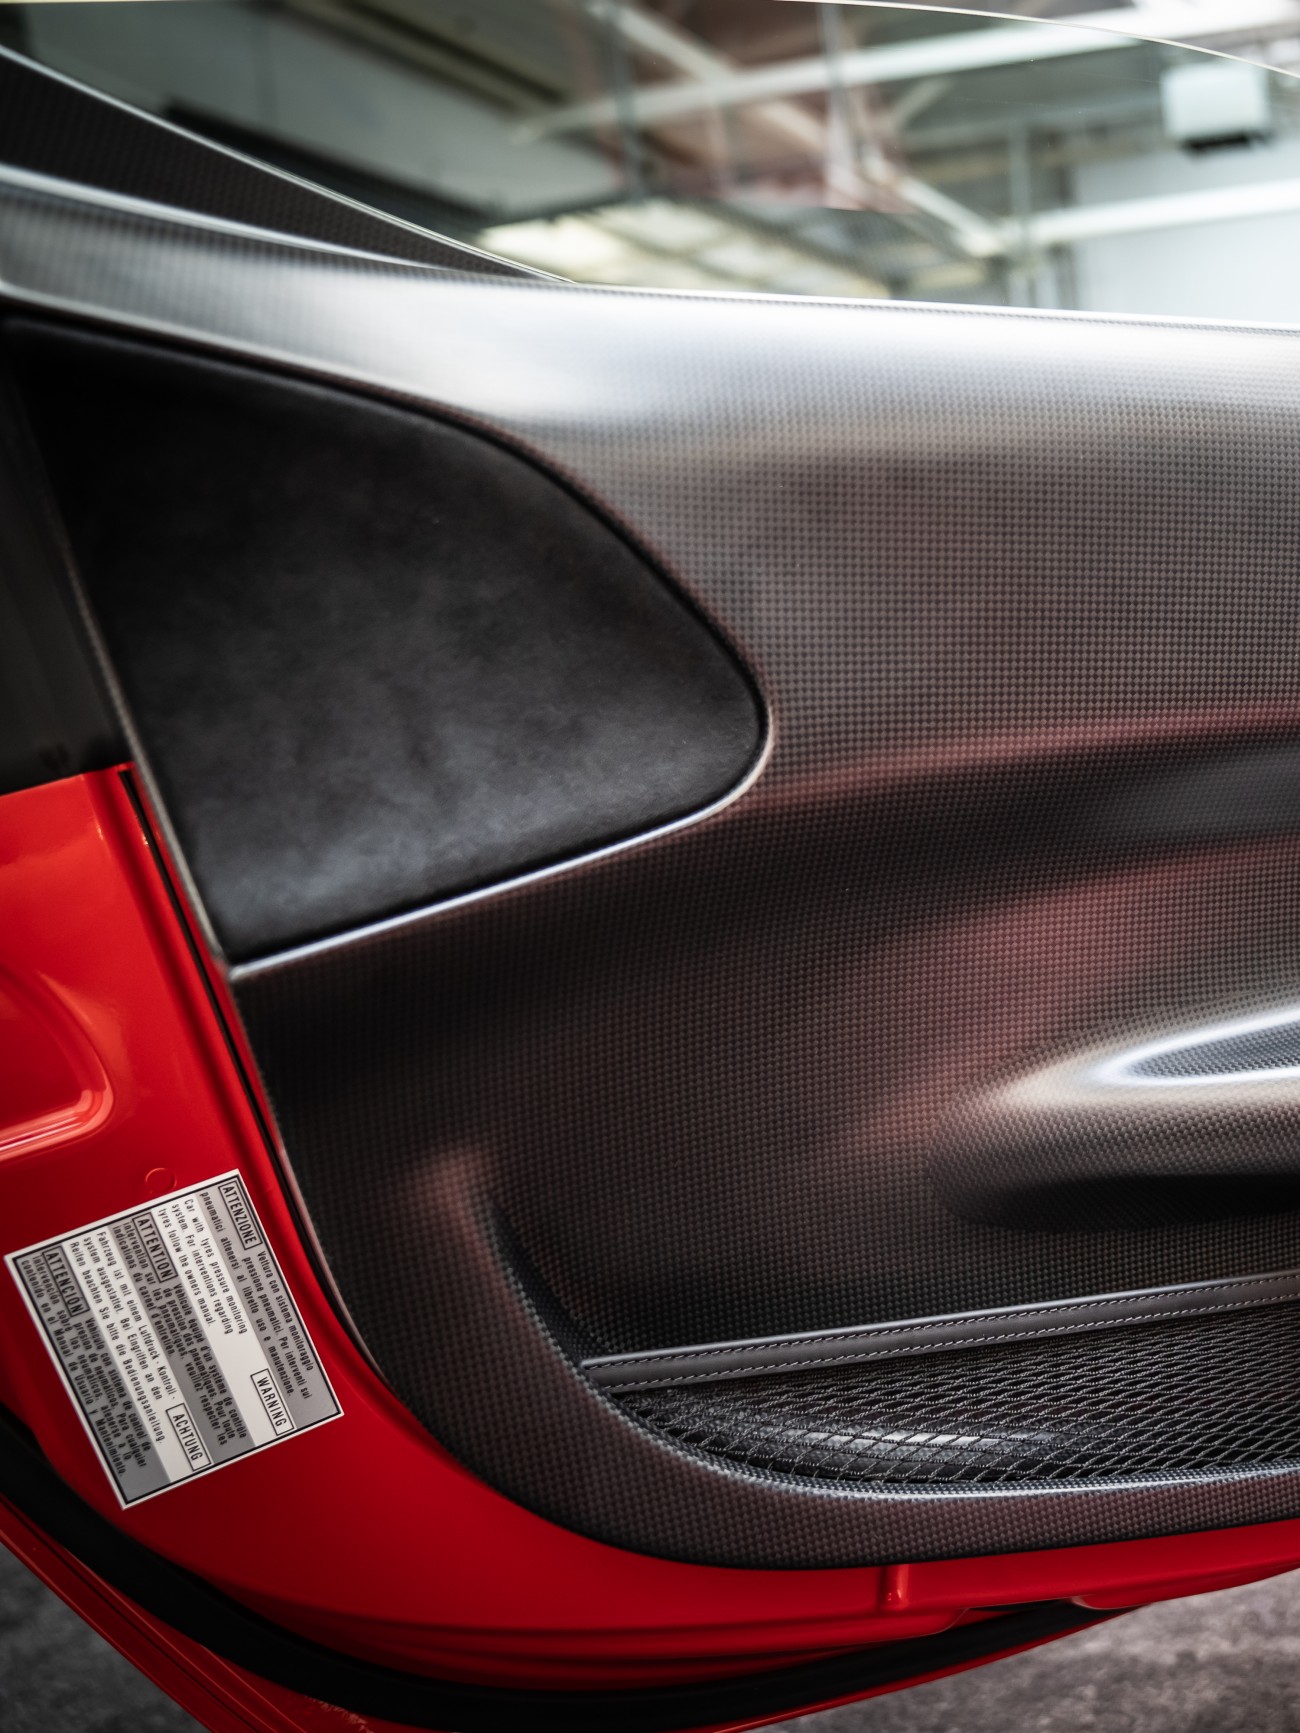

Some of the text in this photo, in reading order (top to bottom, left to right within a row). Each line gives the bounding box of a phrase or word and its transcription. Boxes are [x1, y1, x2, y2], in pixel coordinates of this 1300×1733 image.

[198, 1190, 225, 1233] pneumatici
[221, 1184, 257, 1244] ATTENZIONE
[80, 1235, 102, 1264] system
[93, 1230, 119, 1267] Fahrzeug
[136, 1216, 174, 1278] ATTENTION
[184, 1233, 198, 1248] For
[219, 1235, 242, 1270] attenersi
[45, 1249, 87, 1313] ATTENCIÓN
[111, 1225, 138, 1269] indications
[132, 1271, 144, 1282] du
[138, 1284, 157, 1311] carnet
[112, 1268, 125, 1280] ist
[155, 1207, 217, 1326] tyres follow the owners manual.
[183, 1198, 250, 1334] Car with tyres pressure monitoring
[190, 1248, 219, 1297] interventions
[236, 1273, 247, 1283] al
[241, 1255, 266, 1292] pressione
[68, 1241, 88, 1267] Reifen
[81, 1269, 105, 1304] beachten
[98, 1306, 112, 1320] Sie
[105, 1321, 122, 1341] bitte
[114, 1342, 129, 1356] die
[118, 1282, 132, 1296] mit
[162, 1287, 174, 1298] de
[241, 1285, 261, 1314] libretto
[119, 1316, 133, 1331] Bei
[126, 1298, 144, 1322] einem
[165, 1298, 188, 1332] pression
[210, 1297, 236, 1335] regarding
[255, 1317, 266, 1332] uso
[256, 1250, 315, 1372] Vettura con sistema monitoraggio
[68, 1335, 82, 1350] los
[121, 1221, 150, 1269] intervention
[143, 1272, 155, 1285] sur
[151, 1287, 164, 1301] les
[184, 1361, 205, 1392] veuillez
[197, 1393, 222, 1430] respecter
[216, 1431, 229, 1445] les
[137, 1324, 161, 1359] Luftdruck
[182, 1331, 195, 1346] des
[278, 1335, 291, 1350] Per
[99, 1352, 112, 1366] con
[125, 1332, 151, 1370] Eingriffen
[107, 1368, 128, 1398] sistema
[144, 1372, 154, 1382] an
[156, 1364, 177, 1395] Kontroll
[267, 1344, 297, 1396] manutenzione.
[284, 1350, 307, 1386] interventi
[87, 1351, 100, 1363] de
[115, 1412, 131, 1431] Para
[122, 1399, 134, 1410] de
[150, 1384, 164, 1400] den
[222, 1395, 234, 1406] de
[256, 1376, 287, 1427] WARNING
[300, 1385, 312, 1399] sui
[213, 1400, 227, 1418] Pour
[127, 1411, 147, 1439] control
[172, 1412, 203, 1461] ACHTUNG
[221, 1419, 237, 1439] toute
[140, 1440, 153, 1451] de
